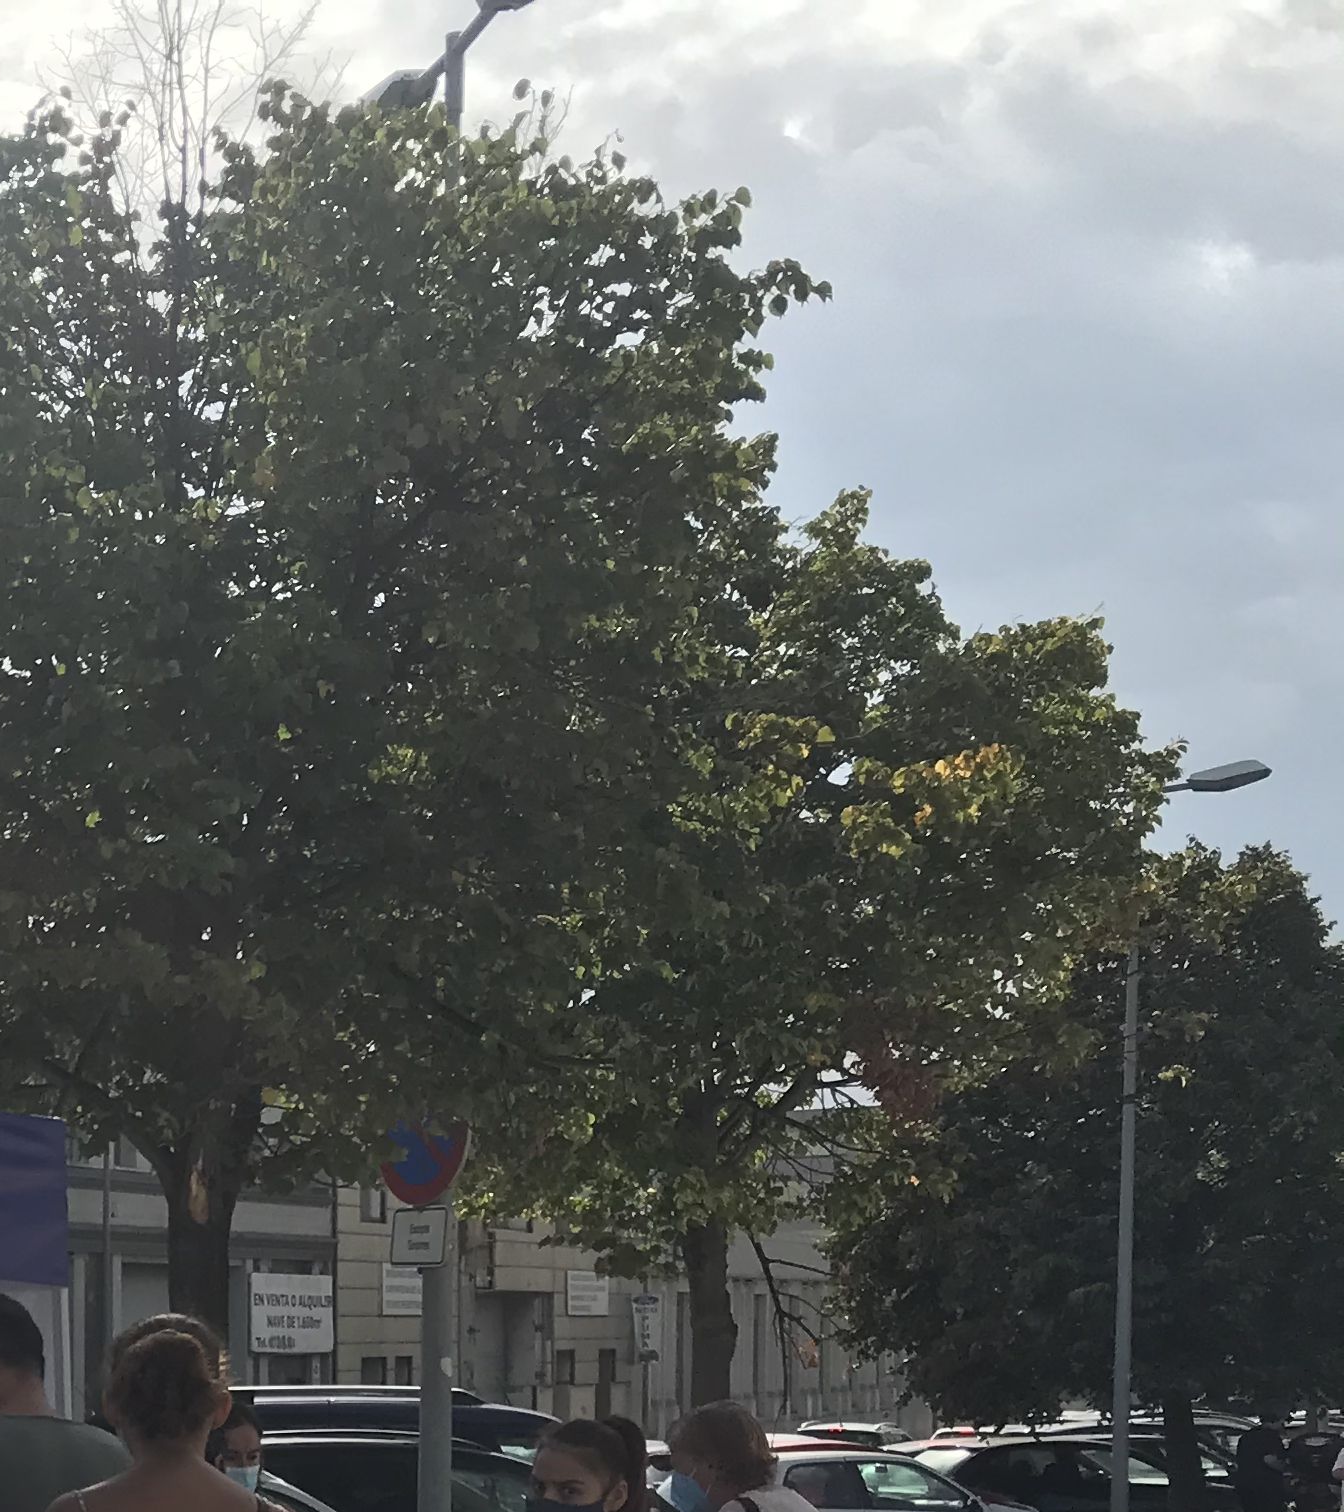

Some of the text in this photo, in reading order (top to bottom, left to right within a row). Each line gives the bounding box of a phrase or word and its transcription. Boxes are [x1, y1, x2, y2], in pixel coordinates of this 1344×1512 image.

[254, 1293, 265, 1306] EN
[266, 1293, 289, 1307] VENTA
[291, 1294, 297, 1307] O
[267, 1315, 285, 1328] NAVE
[287, 1315, 296, 1328] DE
